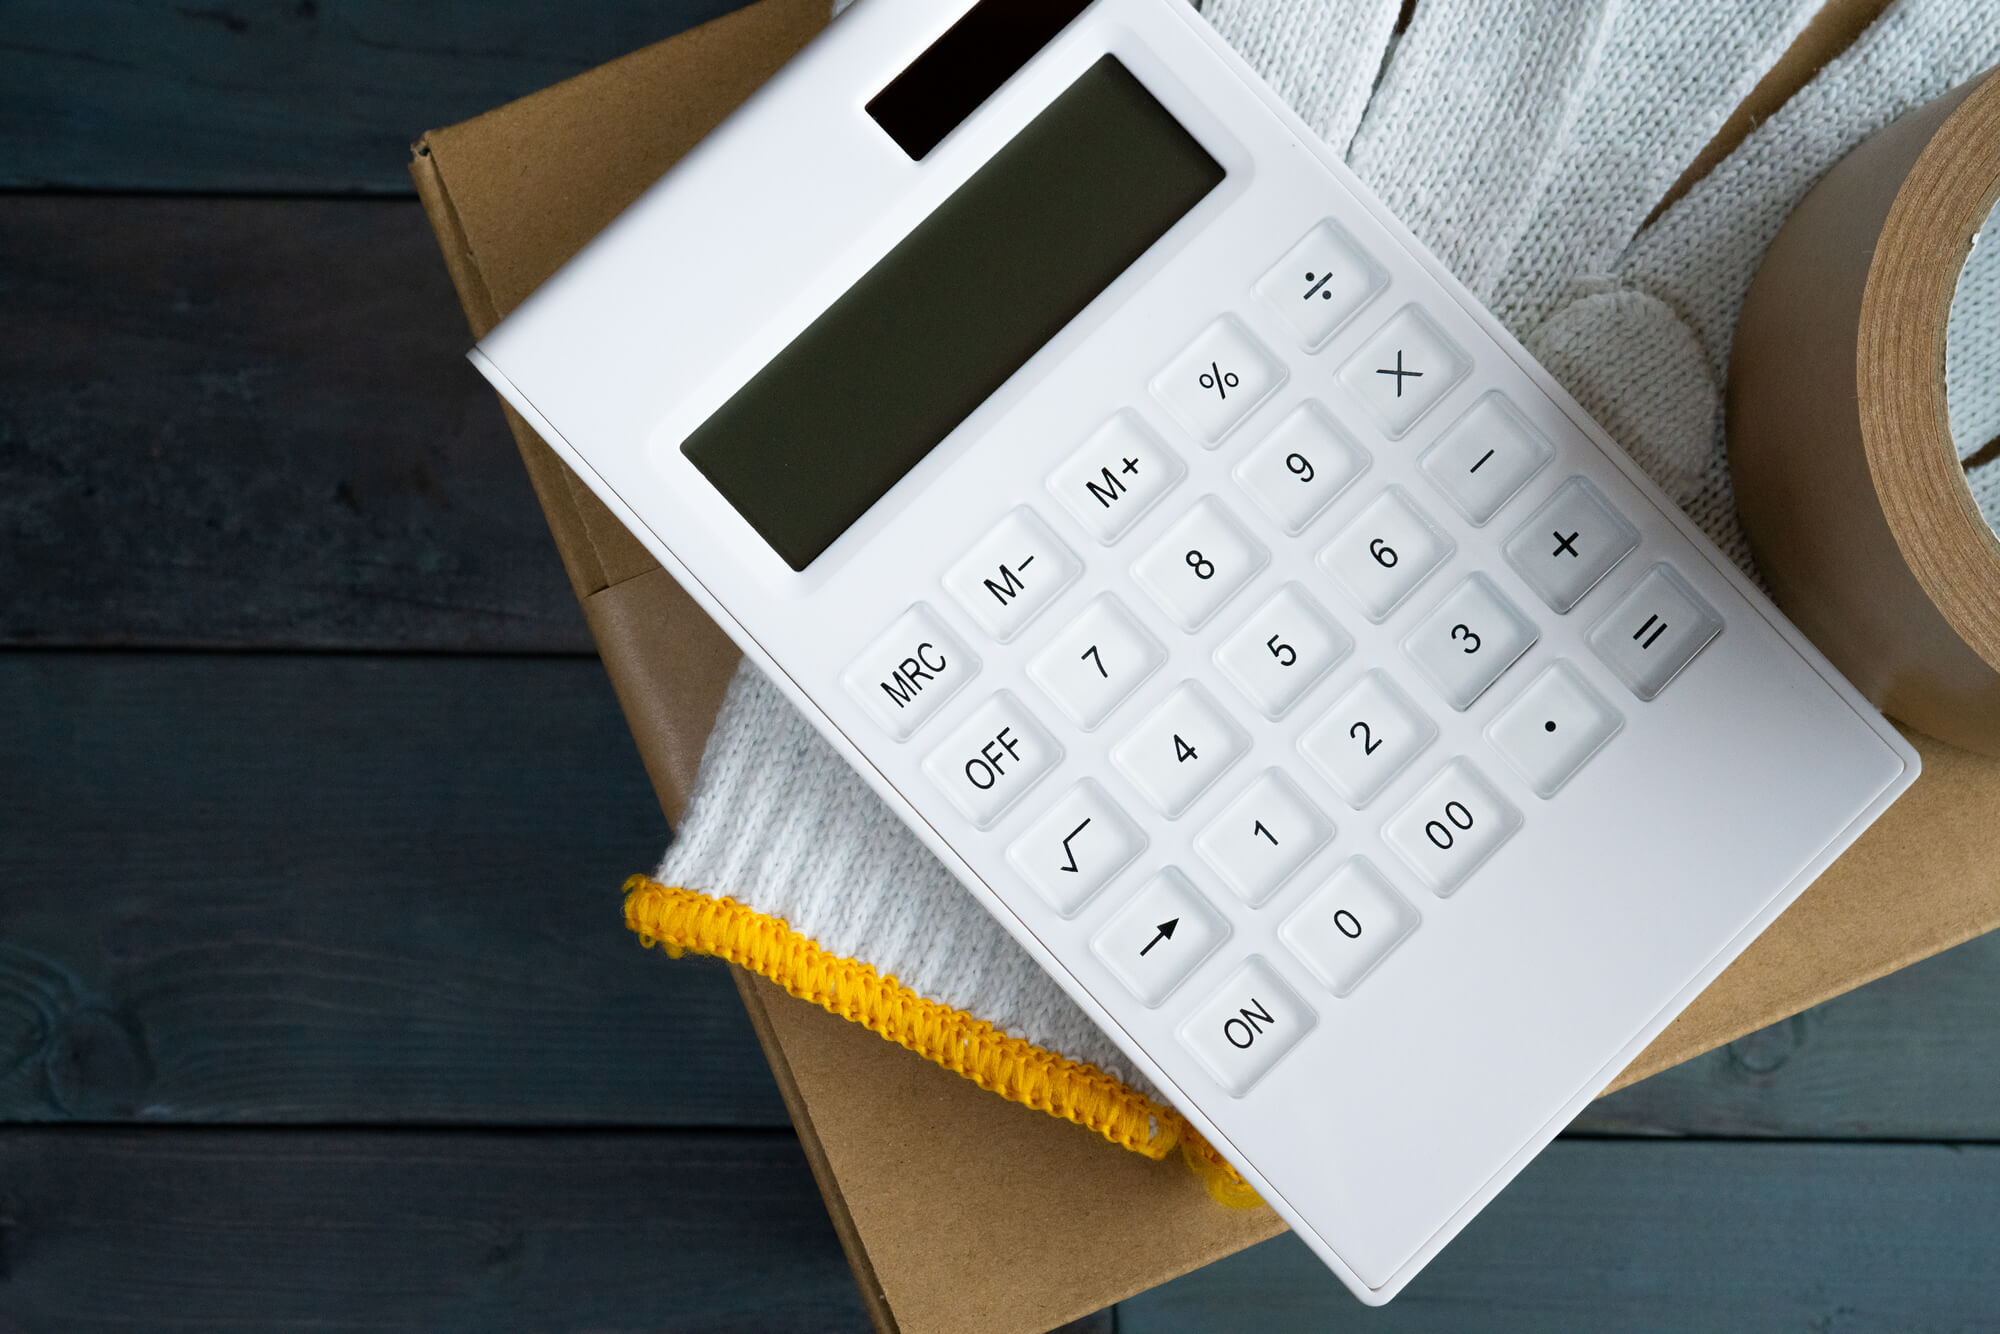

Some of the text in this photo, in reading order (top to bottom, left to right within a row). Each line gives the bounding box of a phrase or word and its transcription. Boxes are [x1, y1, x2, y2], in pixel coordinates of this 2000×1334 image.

[1198, 361, 1240, 401] %
[1085, 457, 1140, 509] M+
[1285, 453, 1316, 484] 9
[1369, 538, 1400, 570] 6
[1551, 529, 1581, 559] +
[983, 555, 1035, 606] M-
[1185, 550, 1216, 581] 8
[1451, 623, 1482, 655] 3
[1631, 613, 1669, 651] =
[1080, 644, 1108, 679] 7
[1266, 633, 1298, 668] 5
[880, 642, 946, 709] MRC
[1173, 733, 1199, 764] 4
[1349, 721, 1384, 757] 2
[965, 725, 1022, 791] OFF
[1254, 819, 1280, 847] 1
[1425, 801, 1475, 851] 00
[1333, 909, 1363, 940] 0
[1224, 997, 1276, 1050] ON
